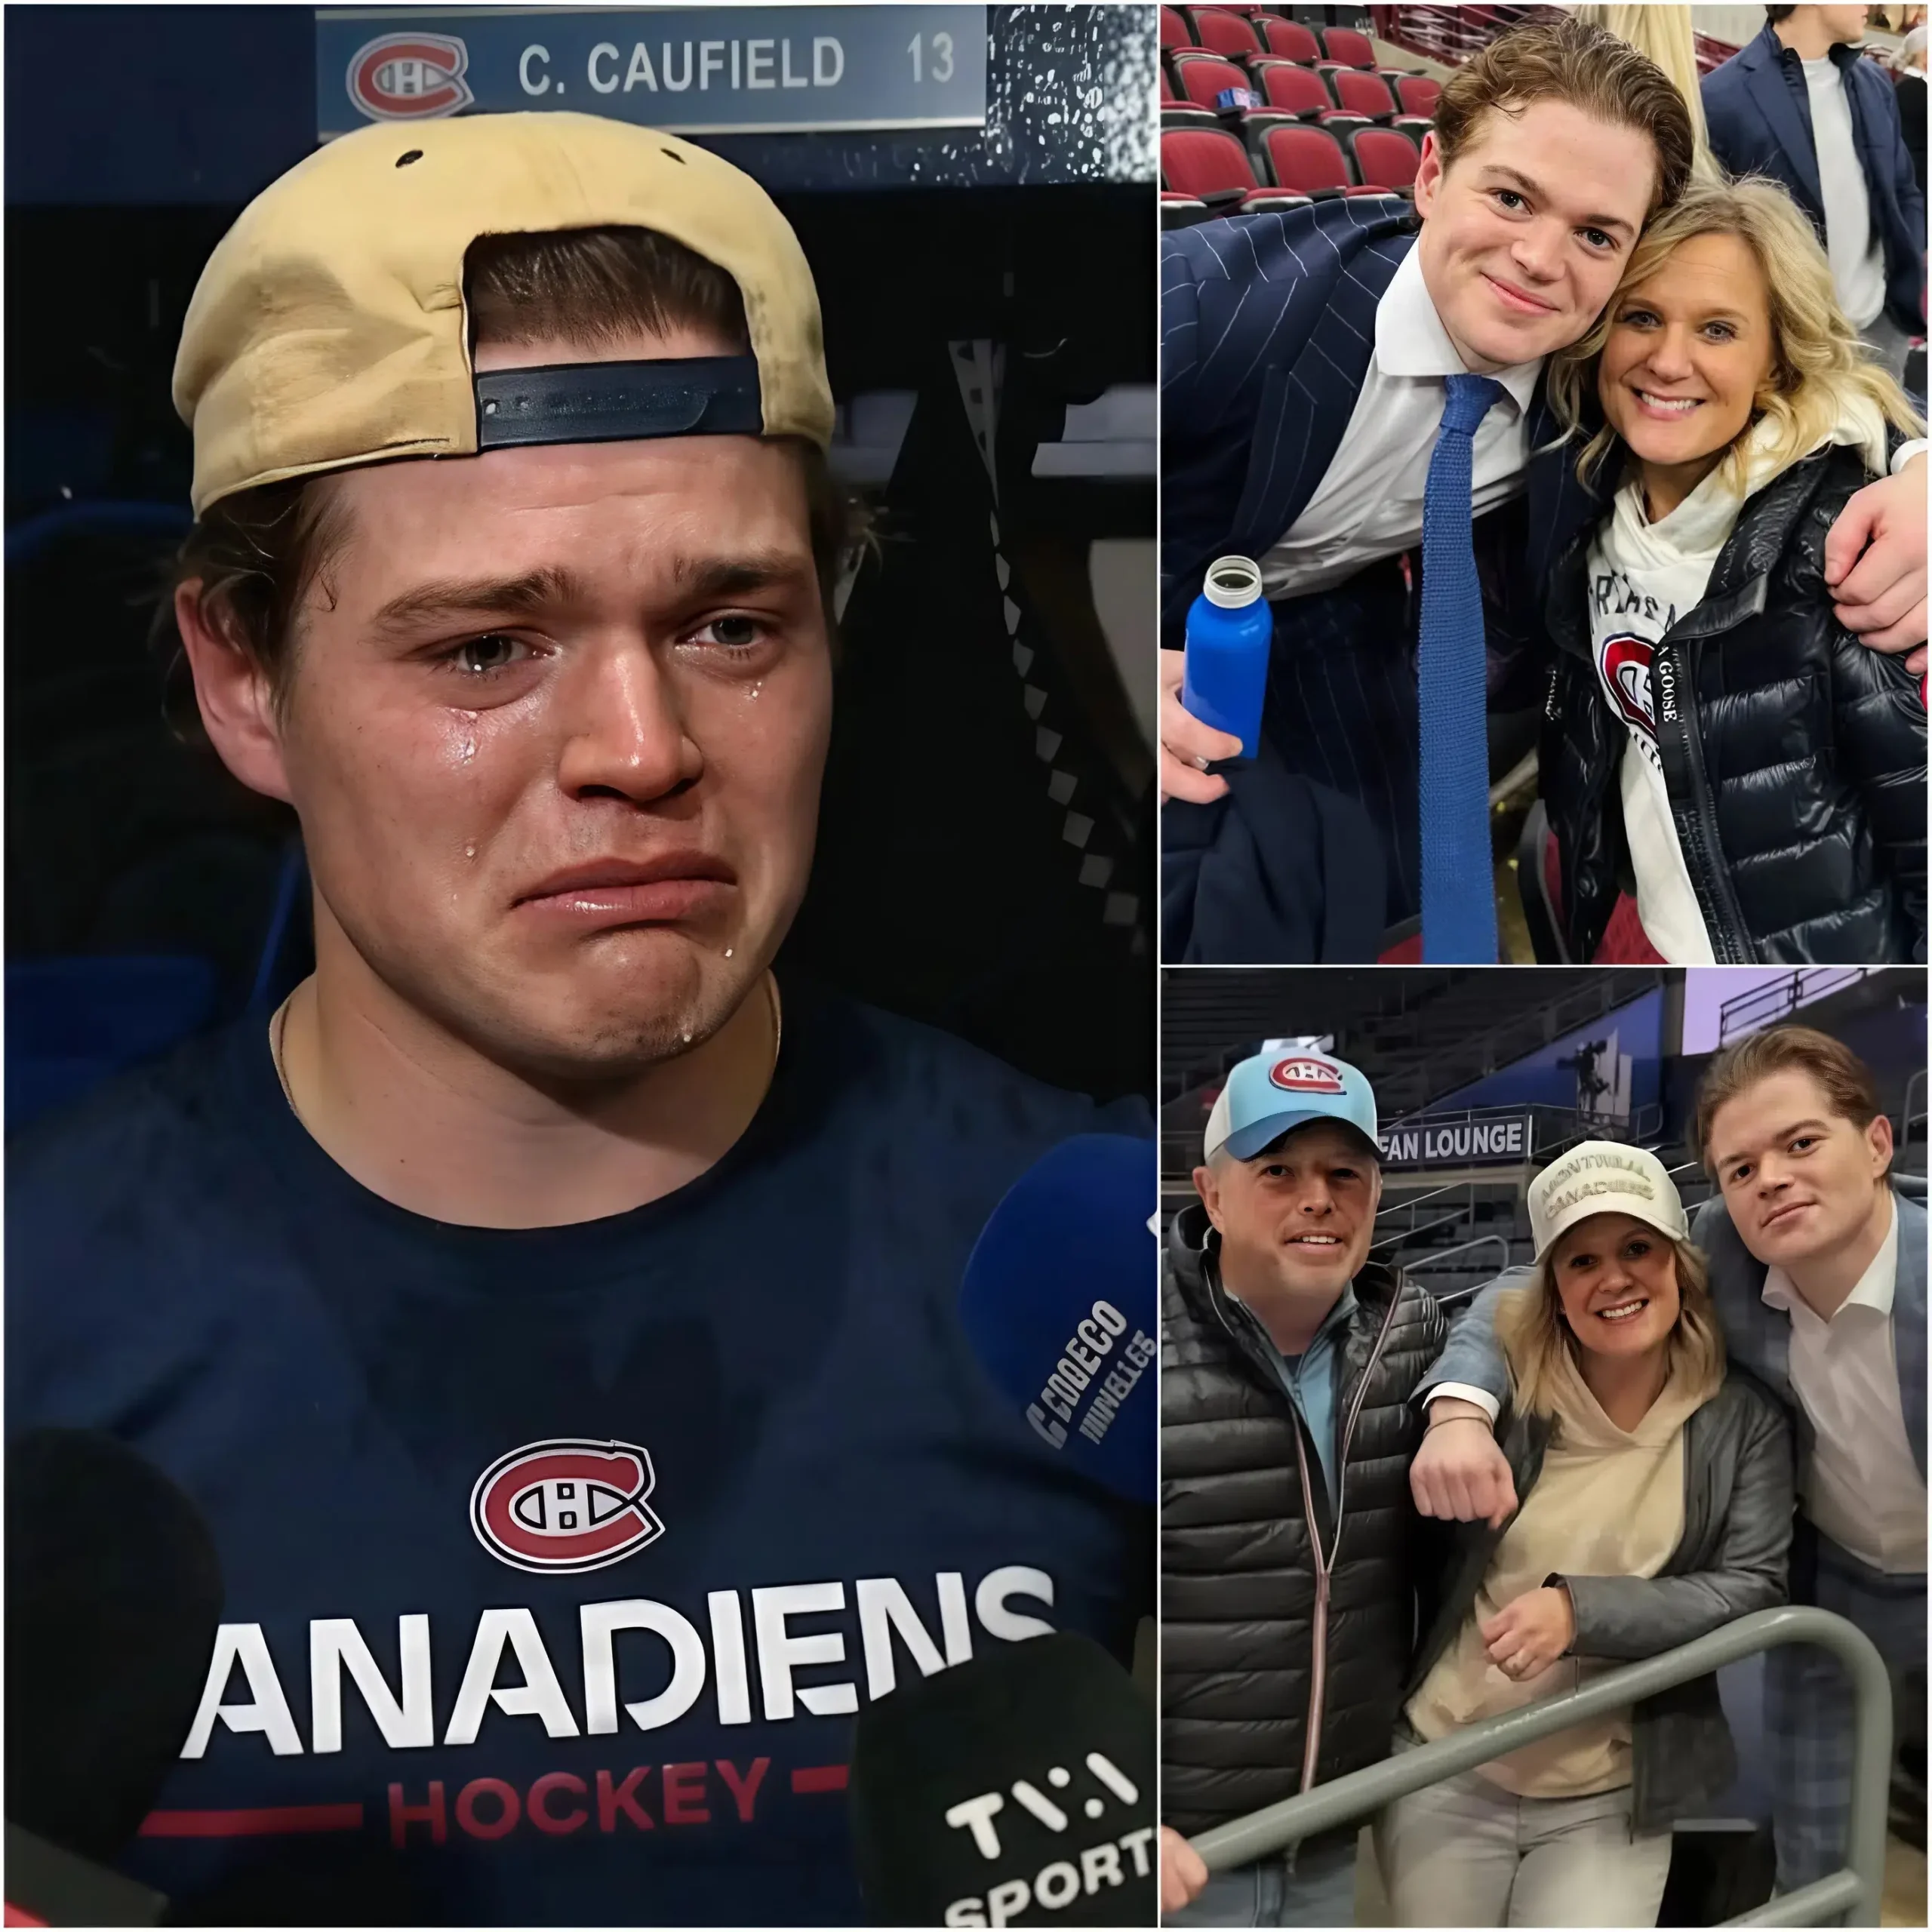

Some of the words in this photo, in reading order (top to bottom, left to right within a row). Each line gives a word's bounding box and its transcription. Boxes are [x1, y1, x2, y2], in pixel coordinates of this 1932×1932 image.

[518, 45, 565, 95] C.
[587, 36, 844, 93] CAUFIELD
[906, 32, 954, 83] 13
[1378, 1133, 1419, 1161] FAN
[1426, 1123, 1521, 1158] LOUNGE
[388, 1757, 771, 1849] HOCKEY
